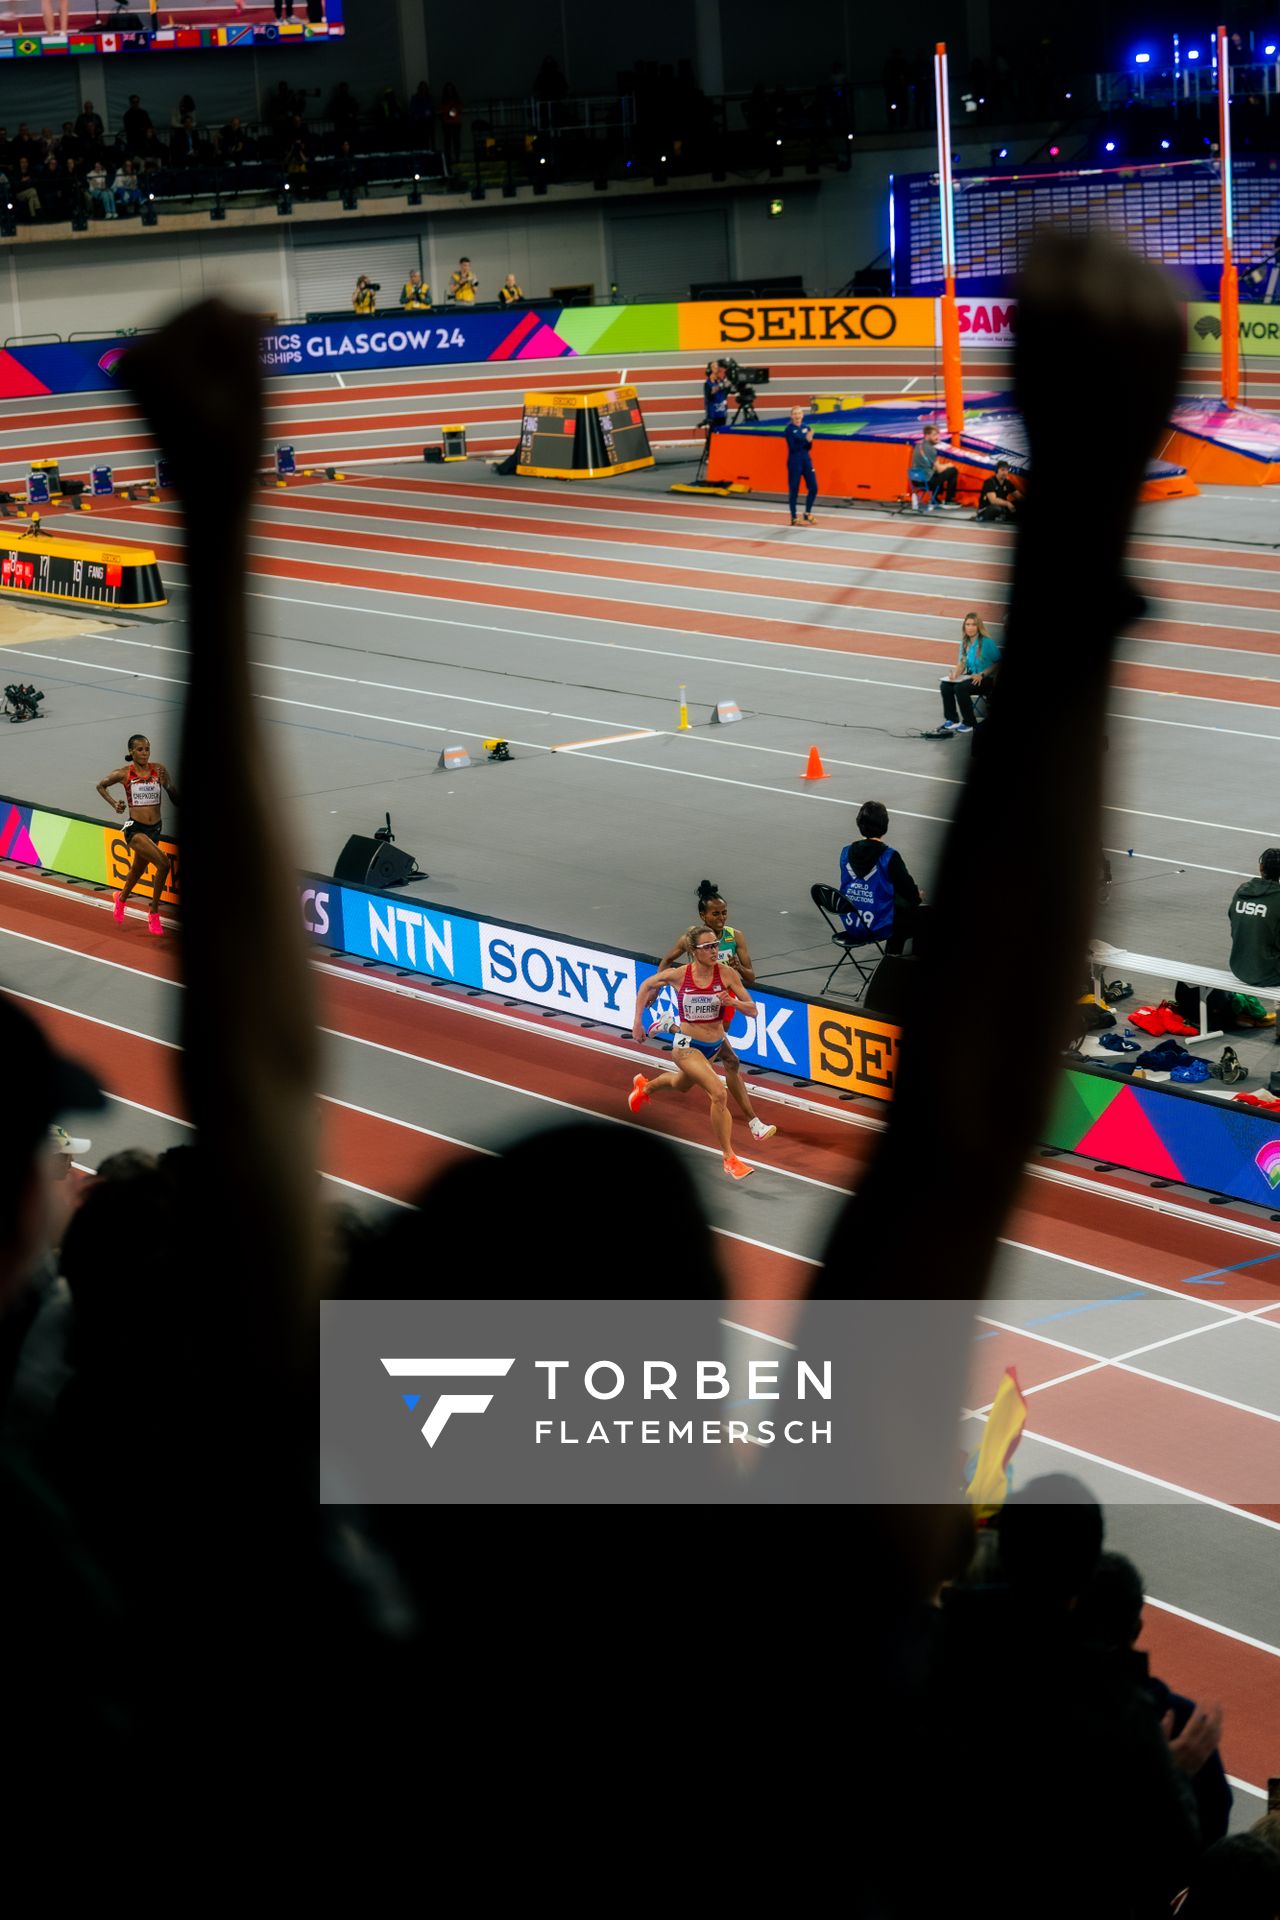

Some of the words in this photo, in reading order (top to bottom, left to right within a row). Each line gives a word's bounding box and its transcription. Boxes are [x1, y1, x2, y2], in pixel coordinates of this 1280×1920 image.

[719, 305, 897, 342] SEIKO
[306, 329, 432, 358] GLASGOW
[436, 327, 466, 350] 24
[87, 565, 104, 580] FANG
[850, 882, 869, 891] WORLD
[1235, 900, 1267, 918] USA
[368, 900, 454, 977] NTN
[488, 938, 627, 1012] SONY
[677, 1037, 687, 1047] 4
